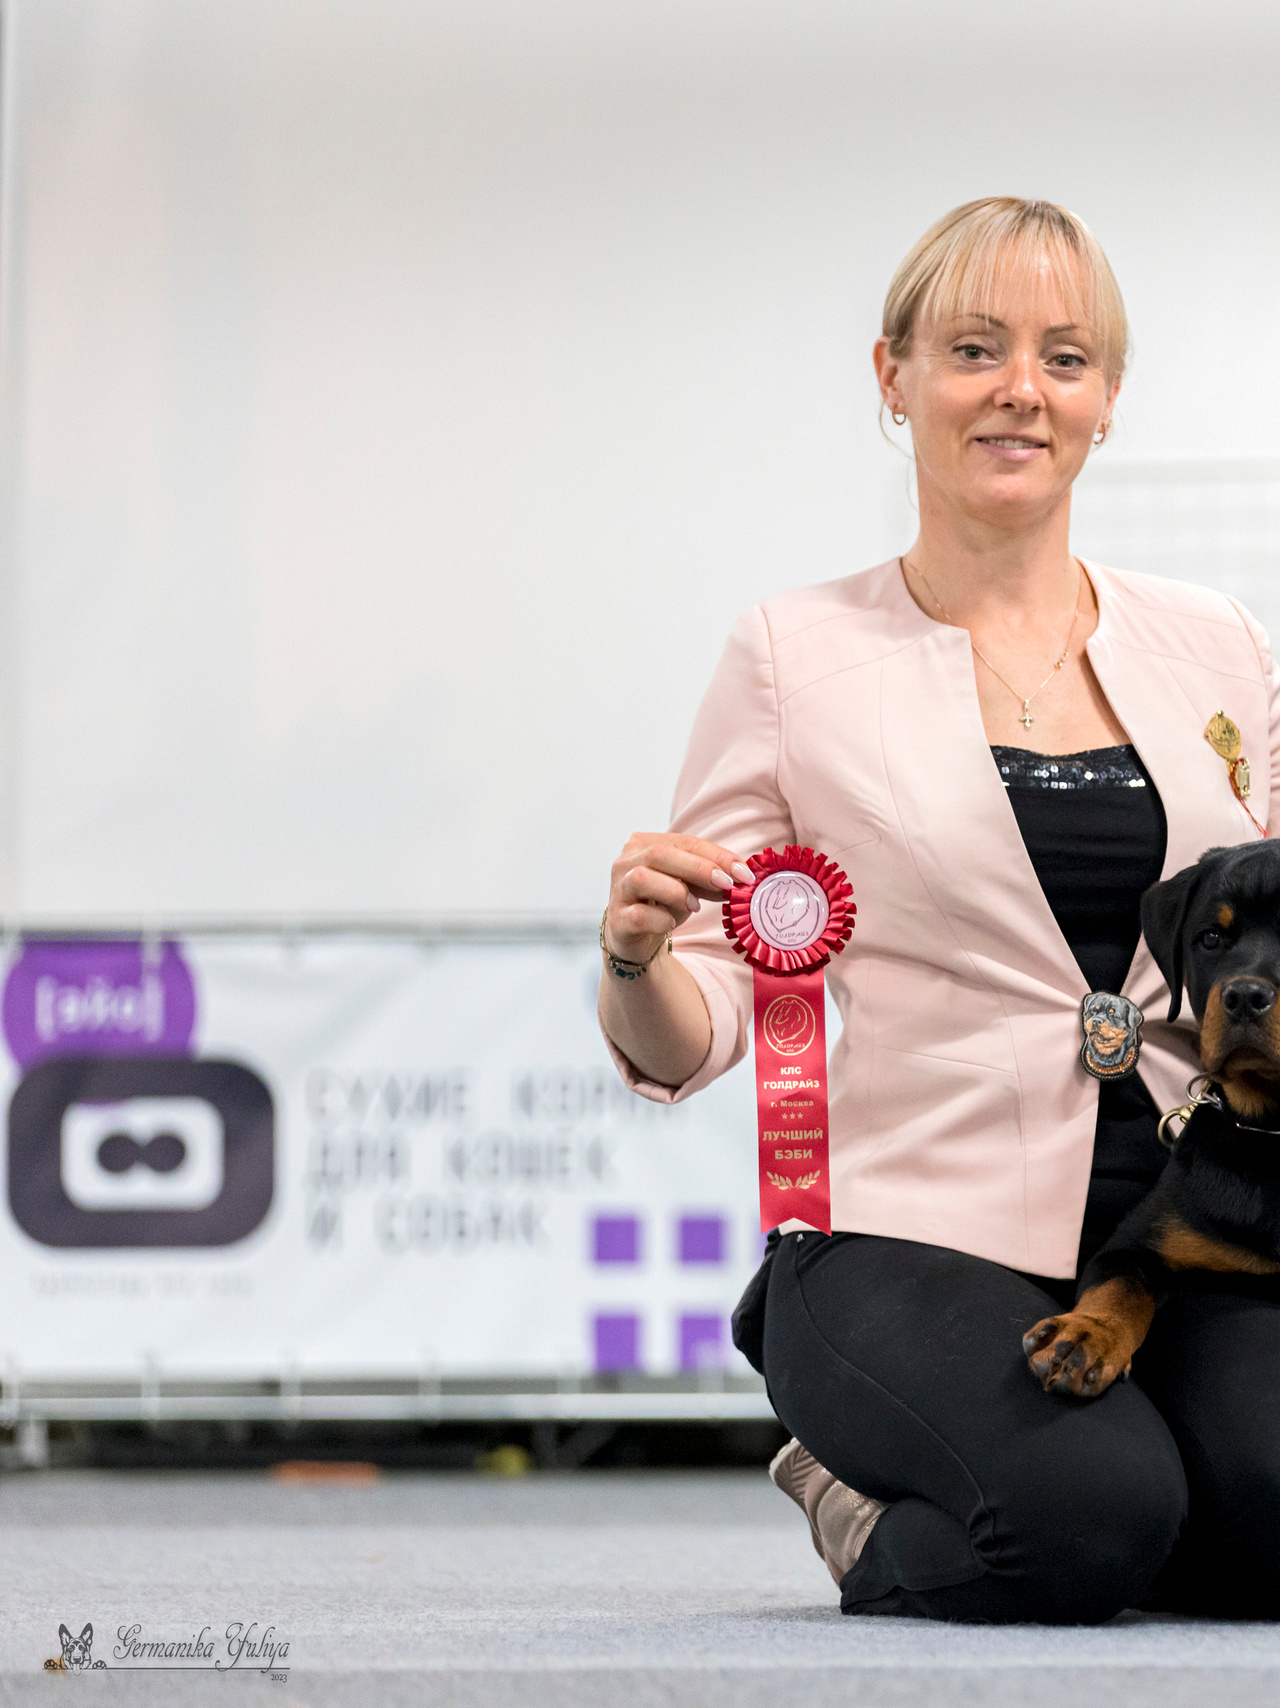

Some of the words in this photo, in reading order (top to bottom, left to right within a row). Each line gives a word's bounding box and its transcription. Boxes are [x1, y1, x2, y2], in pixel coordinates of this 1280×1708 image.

[780, 1066, 802, 1075] КЛС
[763, 1078, 820, 1090] ГОЛДРАЙЗ
[762, 1127, 823, 1141] ЛУЧШИЙ
[774, 1149, 813, 1160] БЭБИ
